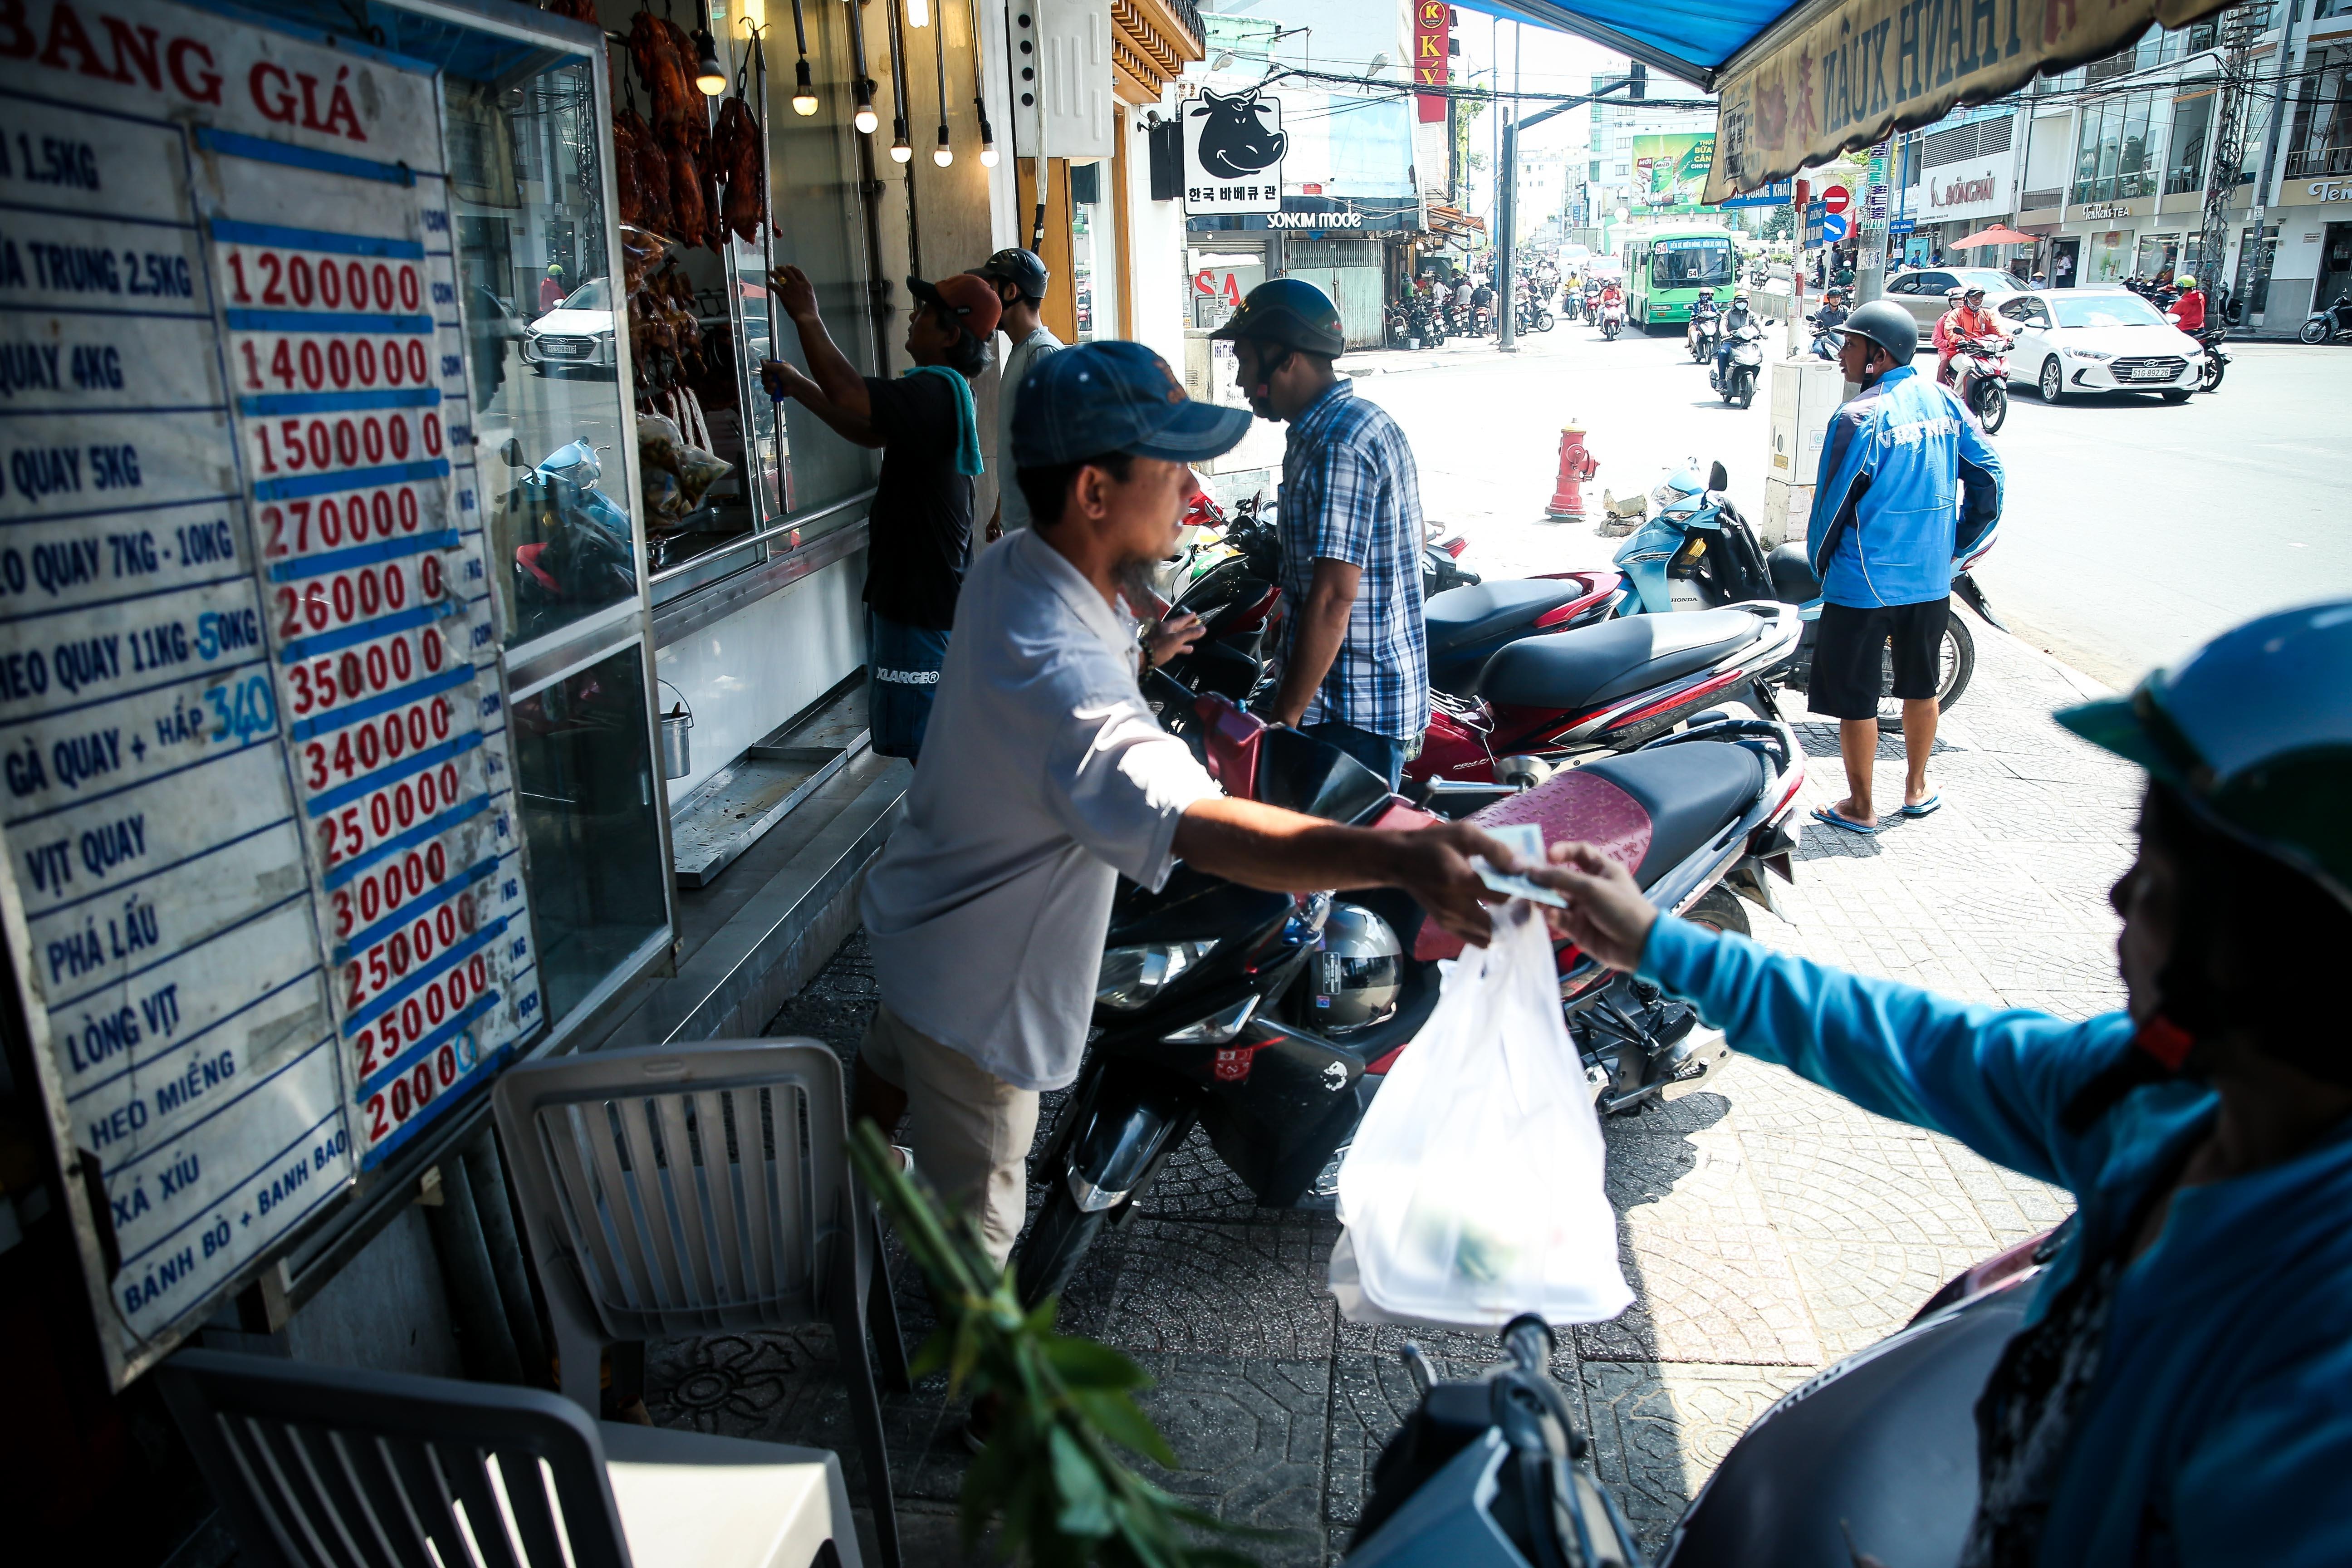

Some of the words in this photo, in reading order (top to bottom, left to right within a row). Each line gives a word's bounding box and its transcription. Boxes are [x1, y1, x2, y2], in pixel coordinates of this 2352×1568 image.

[248, 65, 368, 143] GIÁ
[17, 132, 101, 191] 1.5KG
[1694, 145, 1712, 154] BỮA
[1189, 187, 1215, 202] 한국
[1220, 186, 1259, 201] 바베큐
[1264, 185, 1277, 201] 관
[1267, 212, 1316, 229] SONKIM
[1318, 200, 1362, 229] mode
[1773, 179, 1790, 197] KHẢI
[2113, 207, 2130, 217] TEA
[28, 240, 121, 295] TRUNG
[124, 250, 194, 298] 2.5KG
[227, 251, 420, 312] 1200000
[1657, 243, 1666, 254] 54
[71, 343, 124, 390] 4KG
[240, 338, 427, 391] 1400000
[11, 446, 82, 504] QUAY
[89, 444, 142, 491] 5KG
[260, 486, 418, 559] 270000
[32, 535, 100, 597] QUAY
[108, 529, 158, 578] 7KG
[176, 519, 233, 567] 10KG
[54, 631, 122, 695] QUAY
[129, 621, 189, 672] 11KG
[5, 736, 48, 797] GÀ
[54, 726, 121, 779] QUAY
[305, 696, 450, 792] 340000
[25, 839, 72, 897] VỊT
[82, 813, 148, 874] QUAY
[67, 1015, 141, 1074] LÒNG
[142, 983, 179, 1038] VỊT
[357, 953, 486, 1078] 250000
[89, 1099, 148, 1151] HEO
[157, 1049, 236, 1117] MIẾNG
[112, 1175, 151, 1230] XÁ
[158, 1150, 200, 1204] XÍU
[123, 1244, 194, 1316] BÁNH
[201, 1213, 231, 1259] BÒ
[313, 1129, 346, 1171] BAO
